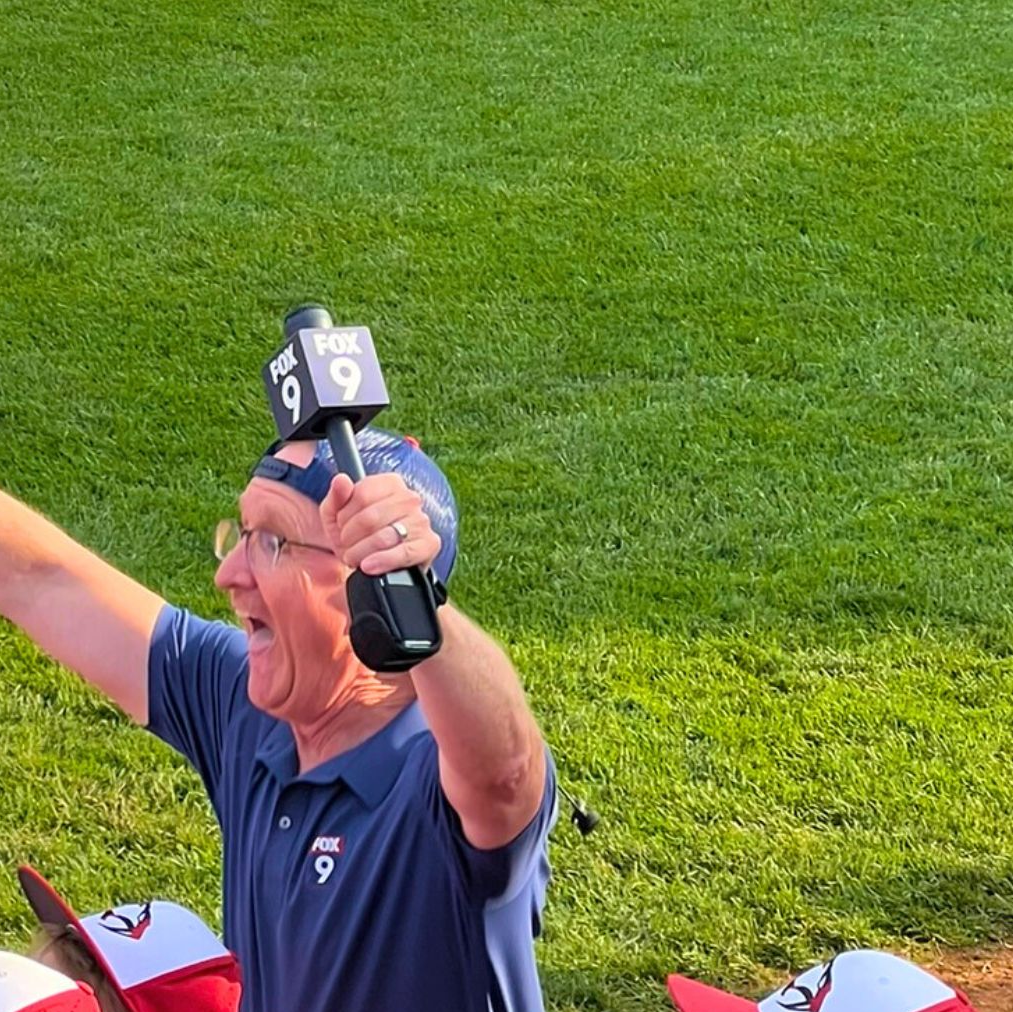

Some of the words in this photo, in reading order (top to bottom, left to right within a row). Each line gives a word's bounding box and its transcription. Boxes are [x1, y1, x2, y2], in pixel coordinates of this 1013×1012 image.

[269, 343, 298, 385] FOX
[313, 332, 363, 356] FOX
[281, 375, 301, 425] 9
[329, 357, 362, 401] 9
[314, 855, 335, 884] 9
